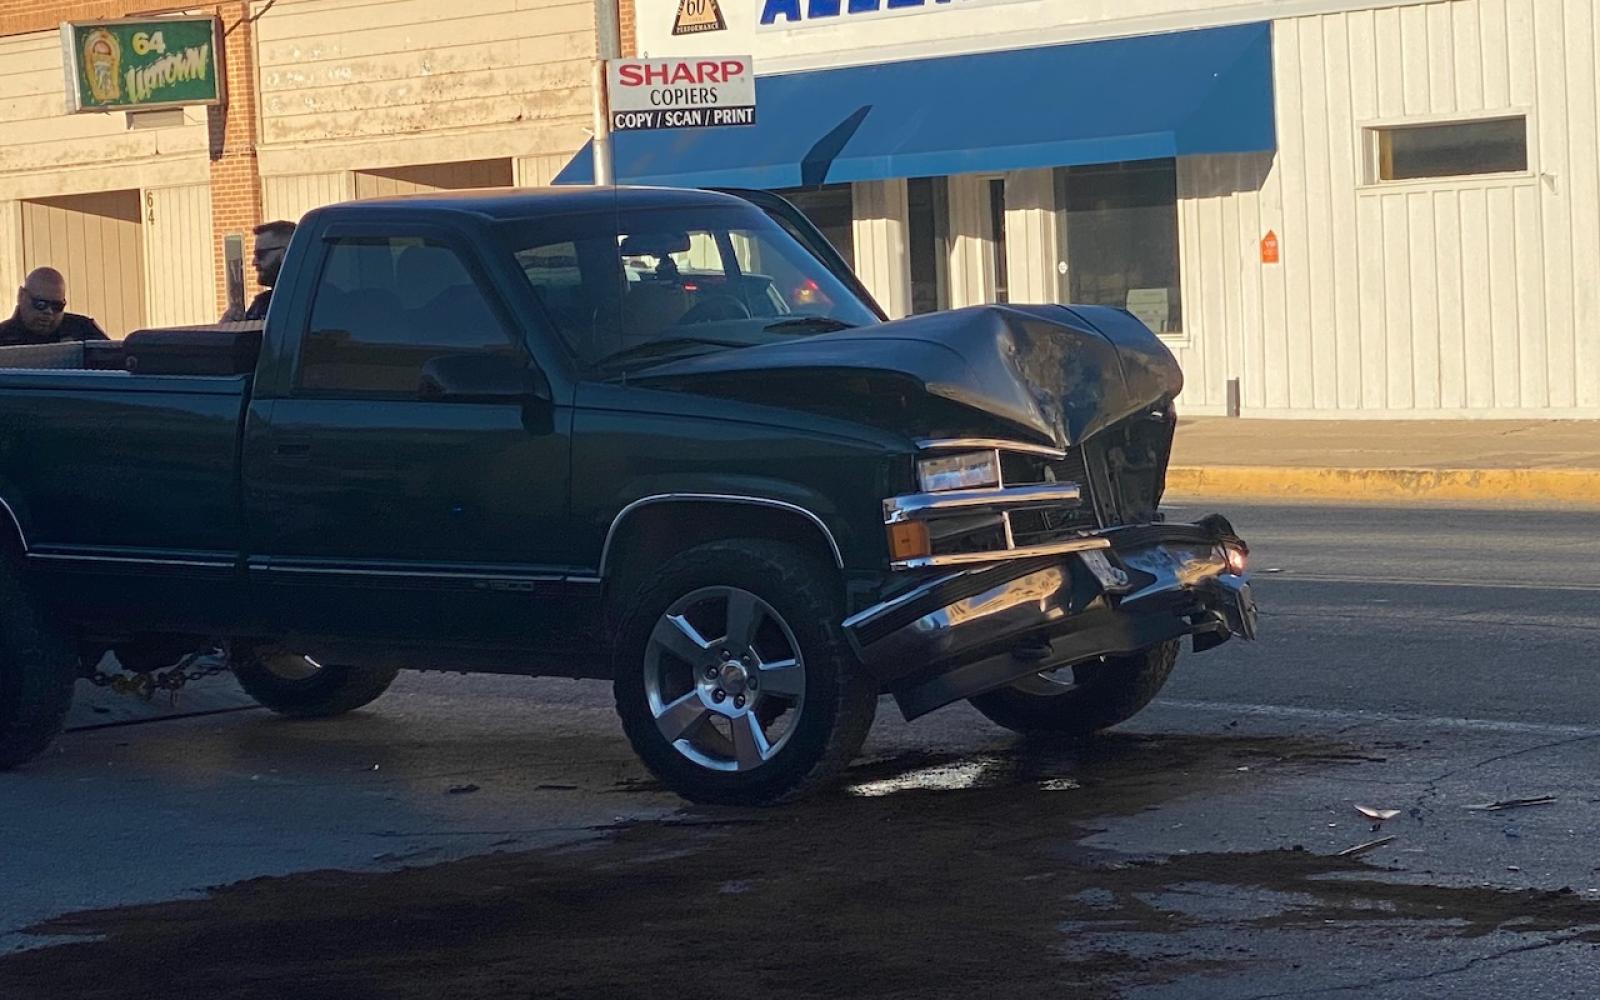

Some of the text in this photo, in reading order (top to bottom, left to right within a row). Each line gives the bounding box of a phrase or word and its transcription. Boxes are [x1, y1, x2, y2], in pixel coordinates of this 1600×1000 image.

[132, 31, 166, 55] 64
[619, 61, 744, 86] SHARP
[650, 87, 718, 105] COPIERS
[614, 112, 653, 129] COPY
[665, 110, 701, 126] SCAN
[714, 108, 754, 125] PRINT
